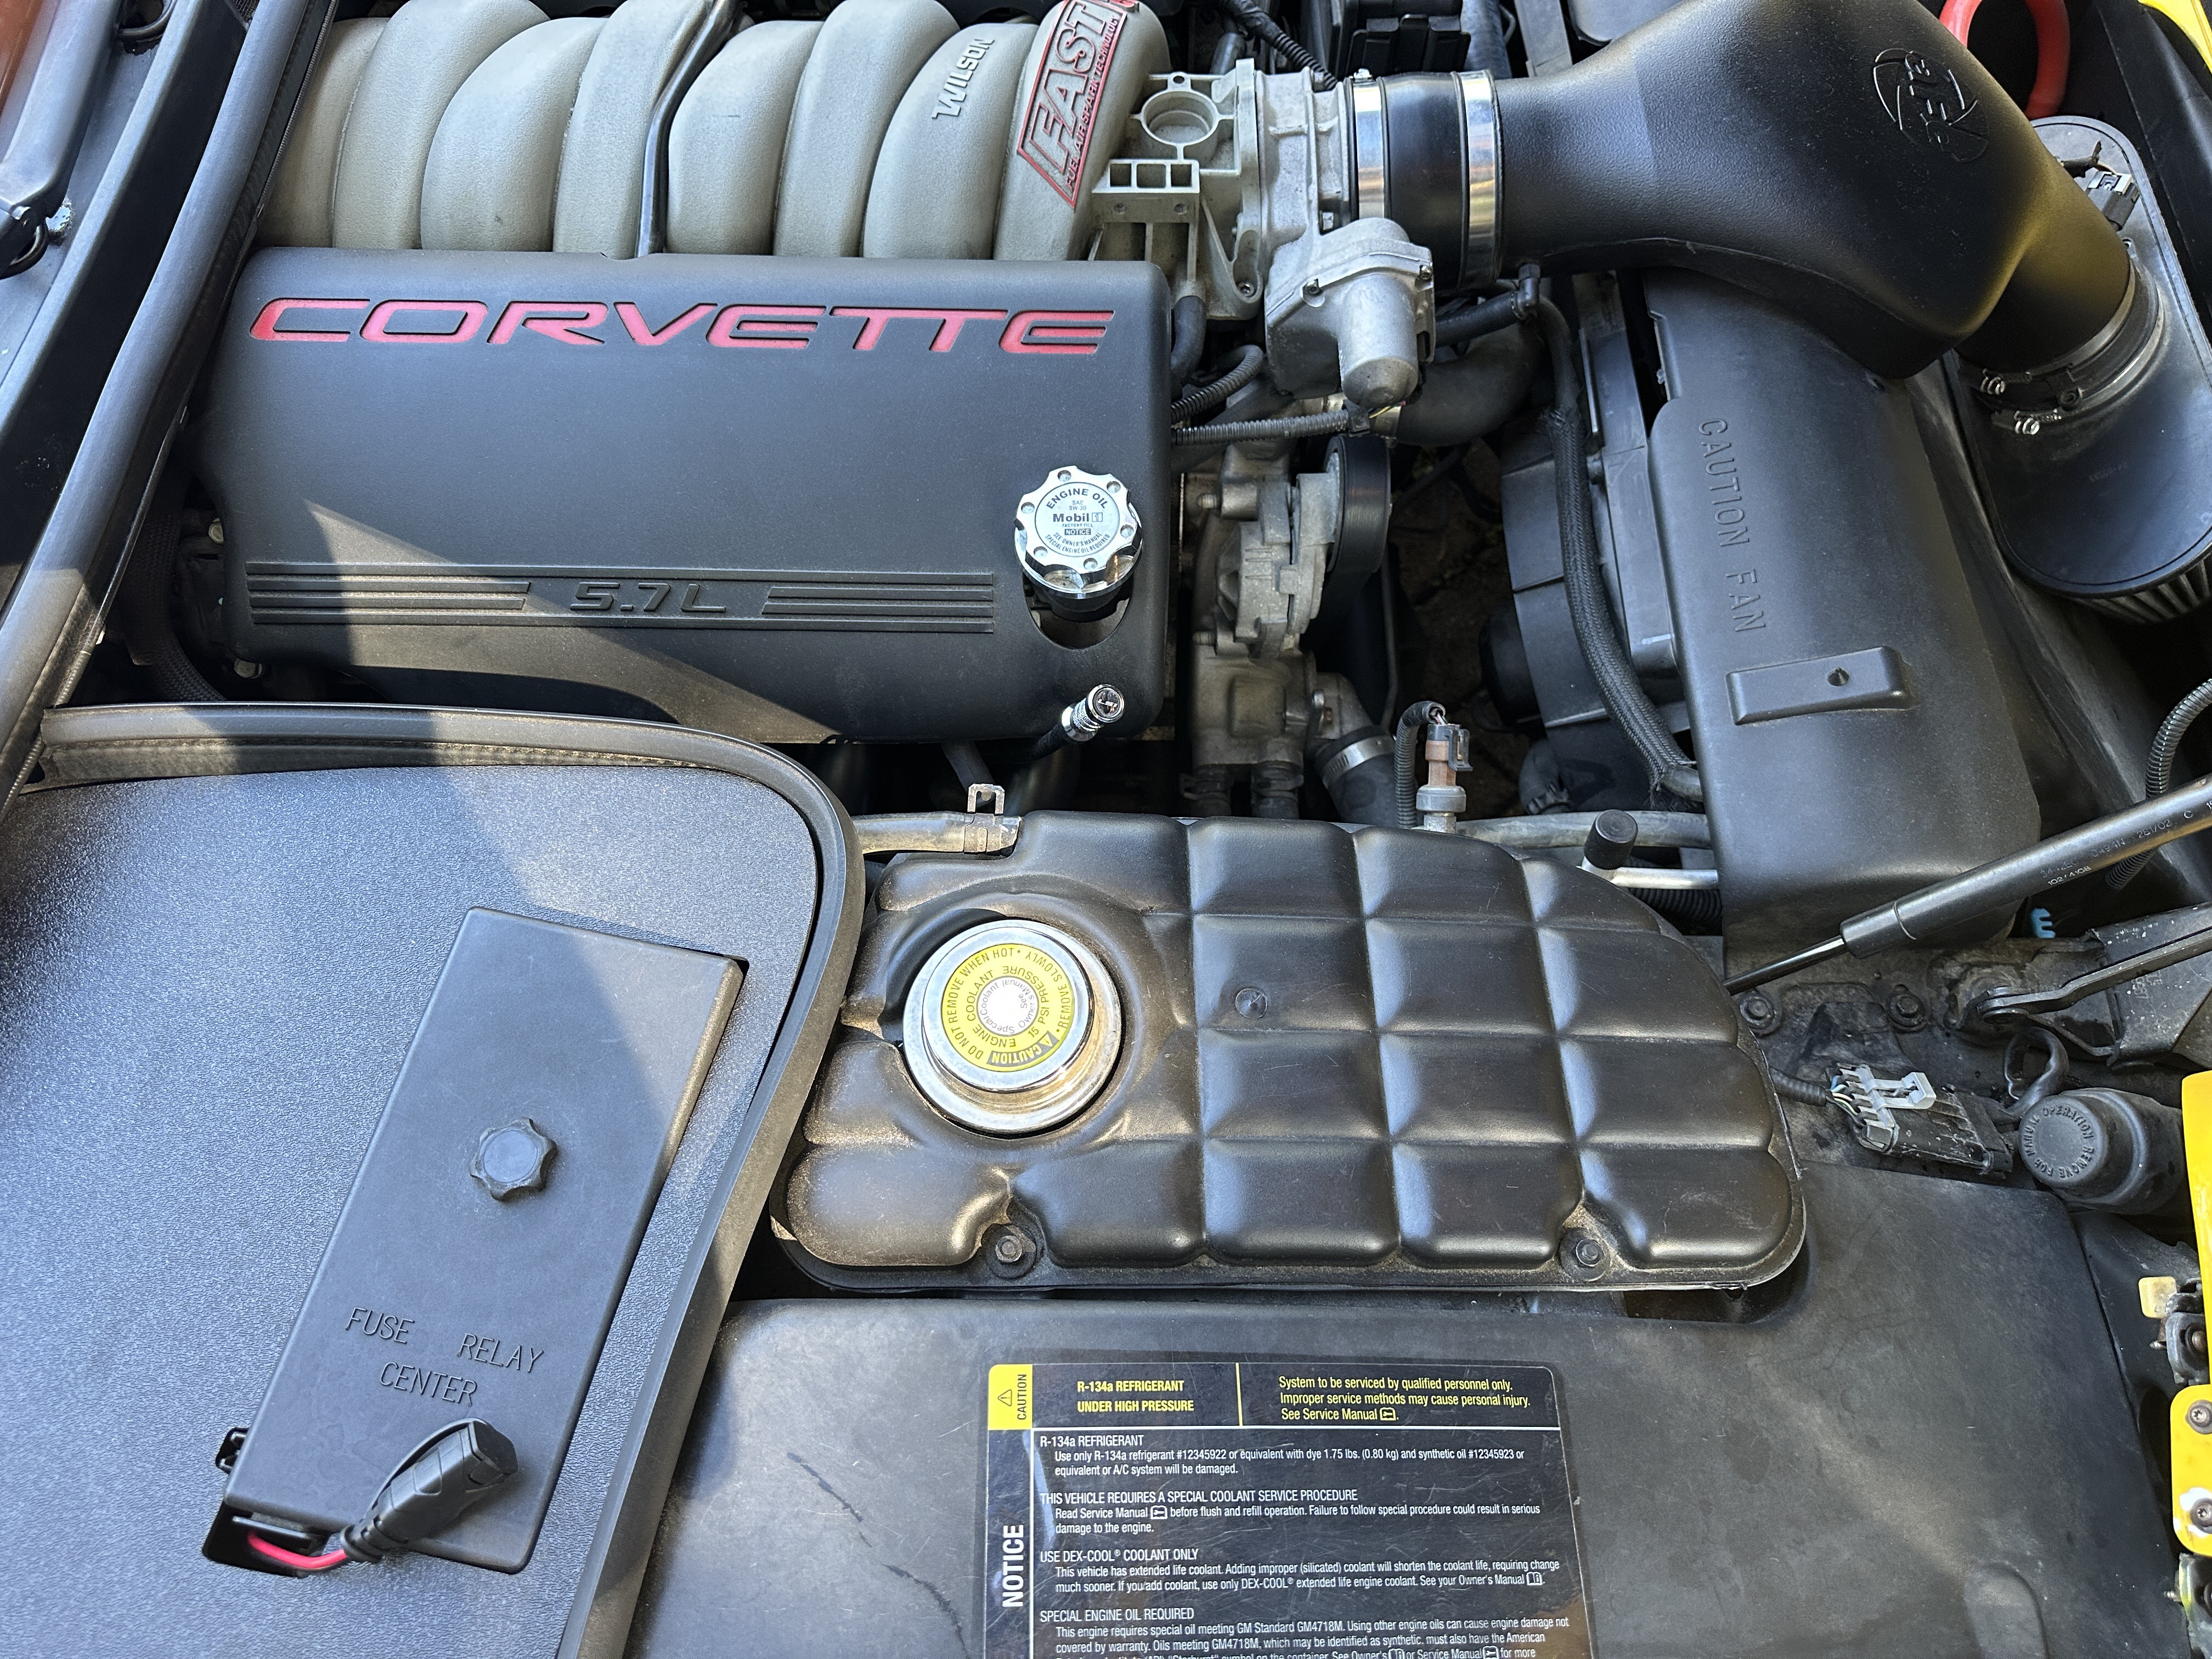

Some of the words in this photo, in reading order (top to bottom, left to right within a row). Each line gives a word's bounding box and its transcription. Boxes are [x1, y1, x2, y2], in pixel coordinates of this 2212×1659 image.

[933, 38, 995, 119] WILSON
[1030, 1, 1106, 173] FAST
[1065, 156, 1080, 190] FUEL
[1074, 123, 1087, 154] AIR
[1081, 79, 1099, 124] SPARK
[250, 298, 1114, 354] CORVETTE
[1046, 488, 1089, 509] ENGINE
[1092, 493, 1109, 509] OIL
[1053, 514, 1089, 522] Mobil
[1698, 417, 1750, 548] CAUTION
[1725, 568, 1766, 633] FAN
[1045, 534, 1062, 551] SPECIAL
[1090, 534, 1110, 552] REQUIRED
[1053, 532, 1062, 540] SEE
[1084, 532, 1102, 545] MANUAL
[570, 582, 726, 612] 5.7L
[994, 947, 1015, 957] HOT
[962, 952, 990, 977] WHEN
[1026, 951, 1063, 982] SLOWLY
[1002, 979, 1031, 996] Manual
[1003, 966, 1050, 1003] PRESSURE
[947, 978, 964, 1024] REMOVE
[966, 969, 994, 1022] COOLANT
[980, 982, 1000, 1015] Coolant
[1019, 994, 1028, 1009] See
[1058, 984, 1070, 1029] REMOVE
[985, 1015, 1015, 1034] Special
[1038, 1007, 1050, 1025] PSI
[951, 1026, 970, 1047] NOT
[973, 1025, 1017, 1048] ENGINE
[1028, 1026, 1040, 1037] 15
[969, 1045, 983, 1060] DO
[992, 1046, 1042, 1064] CAUTION
[345, 1307, 415, 1345] FUSE
[457, 1333, 544, 1373] RELAY
[380, 1362, 477, 1407] CENTER
[1077, 1380, 1113, 1392] R-134a
[1115, 1380, 1184, 1392] REFRIGERANT
[1279, 1376, 1315, 1390] System
[1317, 1376, 1328, 1388] to
[1330, 1376, 1342, 1388] be
[1345, 1376, 1385, 1389] serviced
[1387, 1377, 1399, 1391] by
[1401, 1377, 1442, 1391] qualified
[1444, 1378, 1489, 1391] personnel
[1491, 1379, 1513, 1392] only.
[1017, 1373, 1026, 1420] CAUTION
[1280, 1392, 1324, 1406] Improper
[1327, 1394, 1362, 1404] service
[1364, 1392, 1406, 1404] methods
[1408, 1395, 1428, 1407] may
[1431, 1395, 1458, 1405] cause
[1461, 1394, 1500, 1407] personal
[1503, 1394, 1530, 1408] injury.
[1077, 1401, 1112, 1412] UNDER
[1114, 1400, 1139, 1412] HIGH
[1142, 1400, 1194, 1412] PRESSURE
[1281, 1407, 1300, 1420] See
[1302, 1407, 1339, 1420] Service
[1341, 1408, 1378, 1420] Manual
[1040, 1435, 1075, 1447] R-134a
[1078, 1435, 1144, 1447] REFRIGERANT
[1054, 1451, 1071, 1462] Use
[1074, 1450, 1092, 1463] only
[1094, 1450, 1126, 1461] R-134a
[1129, 1449, 1175, 1462] refrigerant
[1176, 1449, 1226, 1460] #12345922
[1228, 1451, 1238, 1459] or
[1240, 1448, 1284, 1462] equivalent
[1285, 1448, 1304, 1459] with
[1306, 1448, 1321, 1461] dye
[1324, 1448, 1343, 1459] 1.75
[1345, 1448, 1360, 1459] lbs.
[1362, 1448, 1384, 1460] (0.80
[1385, 1448, 1398, 1461] kg)
[1401, 1448, 1416, 1459] and
[1418, 1448, 1455, 1460] synthetic
[1457, 1448, 1466, 1459] oil
[1468, 1448, 1514, 1459] #12345923
[1516, 1451, 1524, 1459] or
[1054, 1465, 1100, 1478] equivalent
[1102, 1466, 1111, 1475] or
[1113, 1464, 1129, 1475] A/C
[1131, 1464, 1162, 1476] system
[1164, 1463, 1180, 1474] will
[1182, 1464, 1193, 1474] be
[1195, 1463, 1238, 1476] damaged.
[1040, 1492, 1062, 1505] THIS
[1064, 1492, 1105, 1504] VEHICLE
[1108, 1491, 1156, 1503] REQUIRES
[1158, 1491, 1165, 1503] A
[1167, 1491, 1208, 1503] SPECIAL
[1210, 1490, 1255, 1502] COOLANT
[1258, 1489, 1298, 1502] SERVICE
[1300, 1489, 1358, 1501] PROCEDURE
[1054, 1508, 1077, 1519] Read
[1080, 1507, 1113, 1519] Service
[1115, 1506, 1148, 1518] Manual
[1170, 1506, 1198, 1517] before
[1200, 1505, 1222, 1517] flush
[1224, 1505, 1240, 1516] and
[1243, 1505, 1262, 1516] refill
[1264, 1505, 1307, 1517] operation.
[1309, 1504, 1338, 1515] Failure
[1339, 1505, 1348, 1515] to
[1350, 1504, 1376, 1515] follow
[1378, 1504, 1408, 1516] special
[1409, 1504, 1451, 1516] procedure
[1453, 1503, 1475, 1514] could
[1477, 1503, 1500, 1514] result
[1502, 1505, 1510, 1514] in
[1511, 1505, 1540, 1514] serious
[1055, 1522, 1091, 1536] damage
[1093, 1522, 1103, 1533] to
[1104, 1522, 1119, 1533] the
[1121, 1521, 1154, 1535] engine.
[1040, 1550, 1060, 1562] USE
[1123, 1548, 1171, 1561] COOLANT
[1172, 1548, 1198, 1560] ONLY
[1002, 1524, 1024, 1608] NOTICE
[1055, 1566, 1075, 1577] This
[1077, 1565, 1108, 1577] vehicle
[1111, 1565, 1127, 1577] has
[1129, 1564, 1170, 1576] extended
[1173, 1564, 1187, 1575] life
[1188, 1564, 1223, 1575] coolant.
[1040, 1609, 1082, 1622] SPECIAL
[1085, 1609, 1122, 1622] ENGINE
[1125, 1609, 1141, 1621] OIL
[1144, 1607, 1194, 1620] REQUIRED
